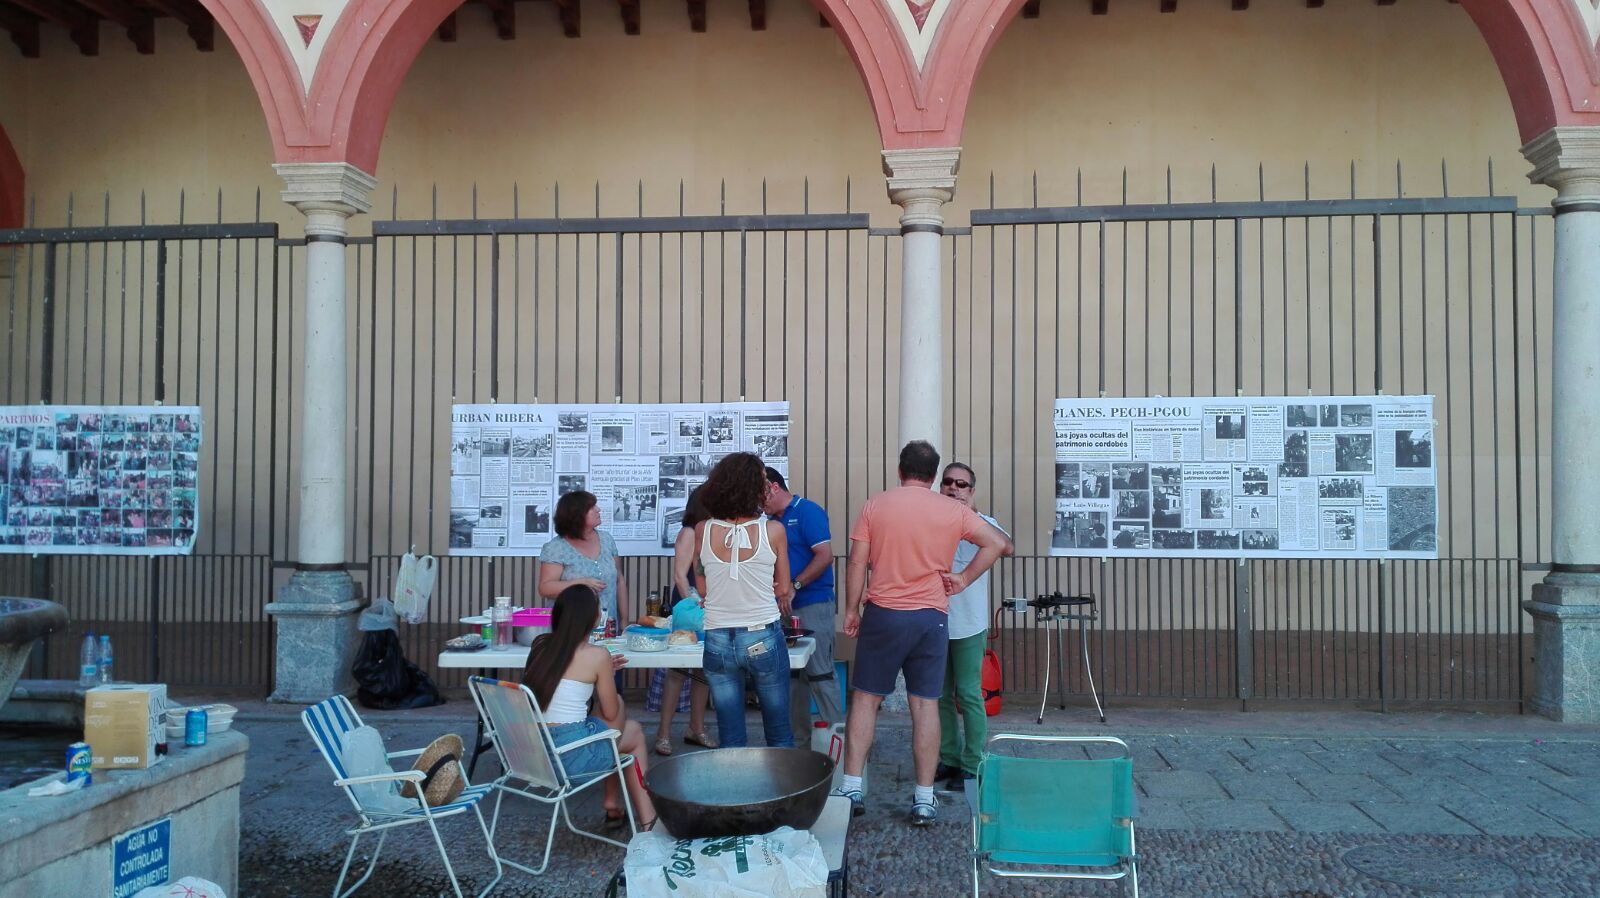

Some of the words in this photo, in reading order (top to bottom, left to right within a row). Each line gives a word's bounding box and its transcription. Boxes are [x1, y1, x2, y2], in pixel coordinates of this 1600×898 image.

[451, 412, 490, 423] URBAN
[495, 412, 543, 423] RIBERA
[1054, 407, 1106, 418] PLANES.
[1110, 406, 1192, 418] PECH-PGOU
[1069, 432, 1088, 441] joyas
[127, 833, 146, 853] AGUA
[148, 828, 158, 845] NO
[120, 847, 163, 877] CONTROLADA
[114, 864, 168, 898] SANITARIAMENTE
